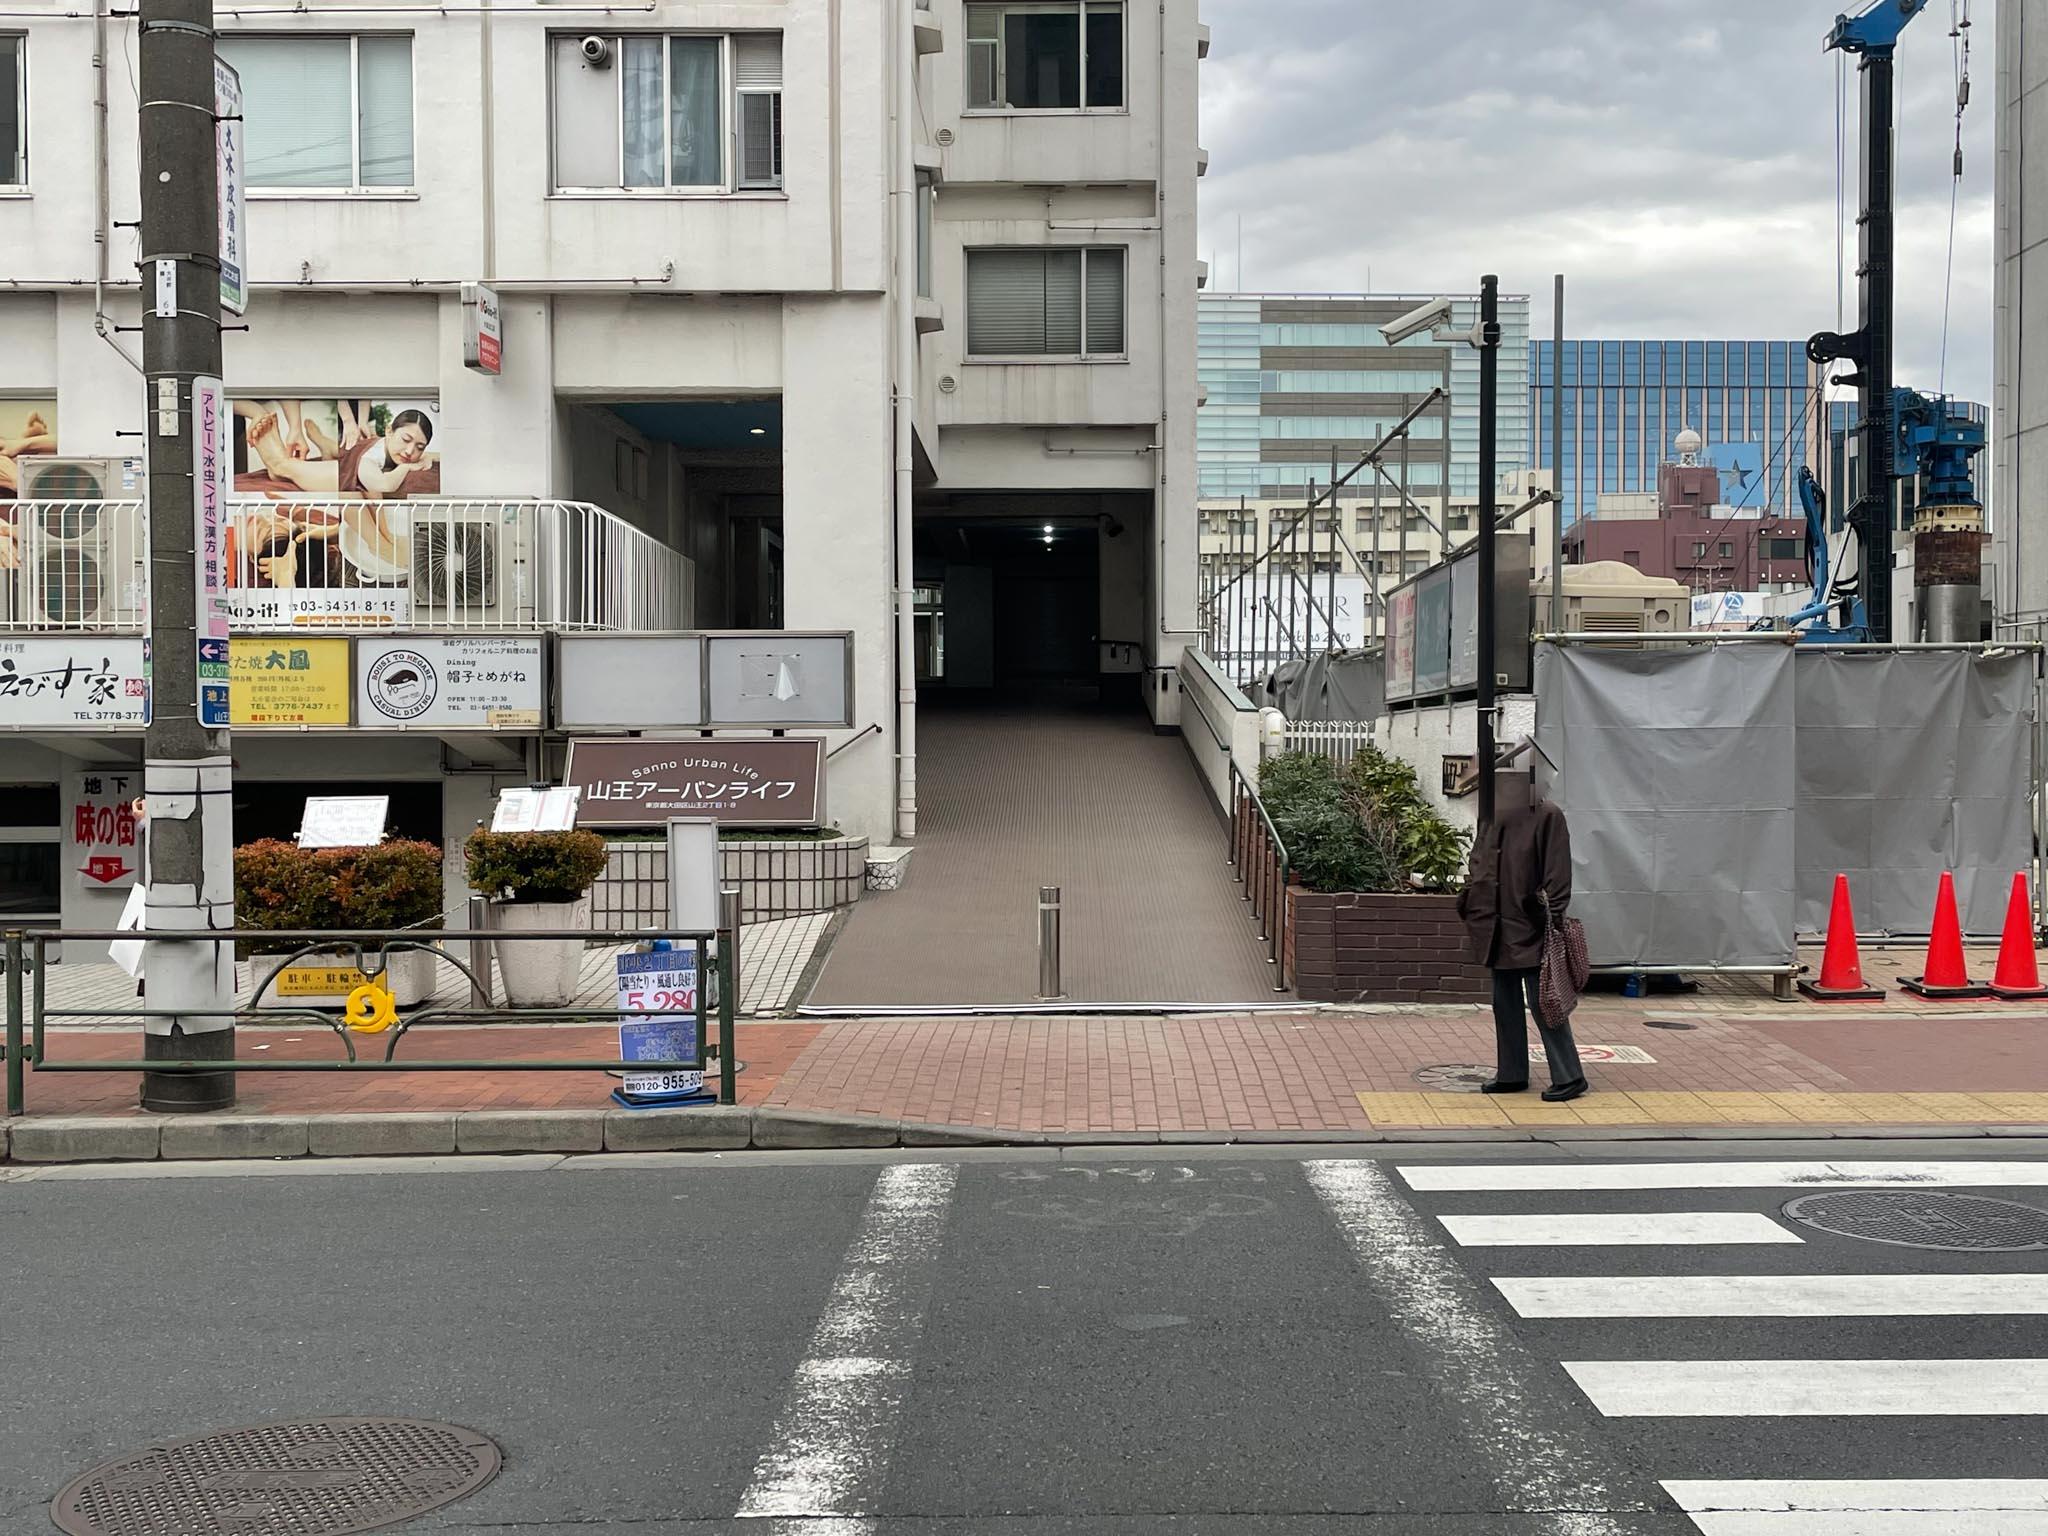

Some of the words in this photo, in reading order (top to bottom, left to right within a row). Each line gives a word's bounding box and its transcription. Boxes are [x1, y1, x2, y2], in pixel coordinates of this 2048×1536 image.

[205, 559, 217, 588] 相談
[462, 647, 538, 655] カリフォルニア料理のお店
[372, 657, 392, 681] BOUSI
[393, 653, 405, 661] TO
[446, 659, 476, 667] Dining
[0, 656, 119, 706] えびす家
[447, 670, 526, 684] 帽子とめがね
[74, 711, 92, 720] TEL
[373, 694, 401, 716] CASUAL
[404, 694, 432, 716] DINING
[631, 760, 677, 779] Sanno
[683, 757, 728, 770] Urban
[732, 762, 760, 780] Life
[84, 776, 129, 795] 地下
[586, 780, 796, 801] 山王アーバンライフ
[75, 800, 136, 847] 味の街
[92, 863, 120, 875] 地下
